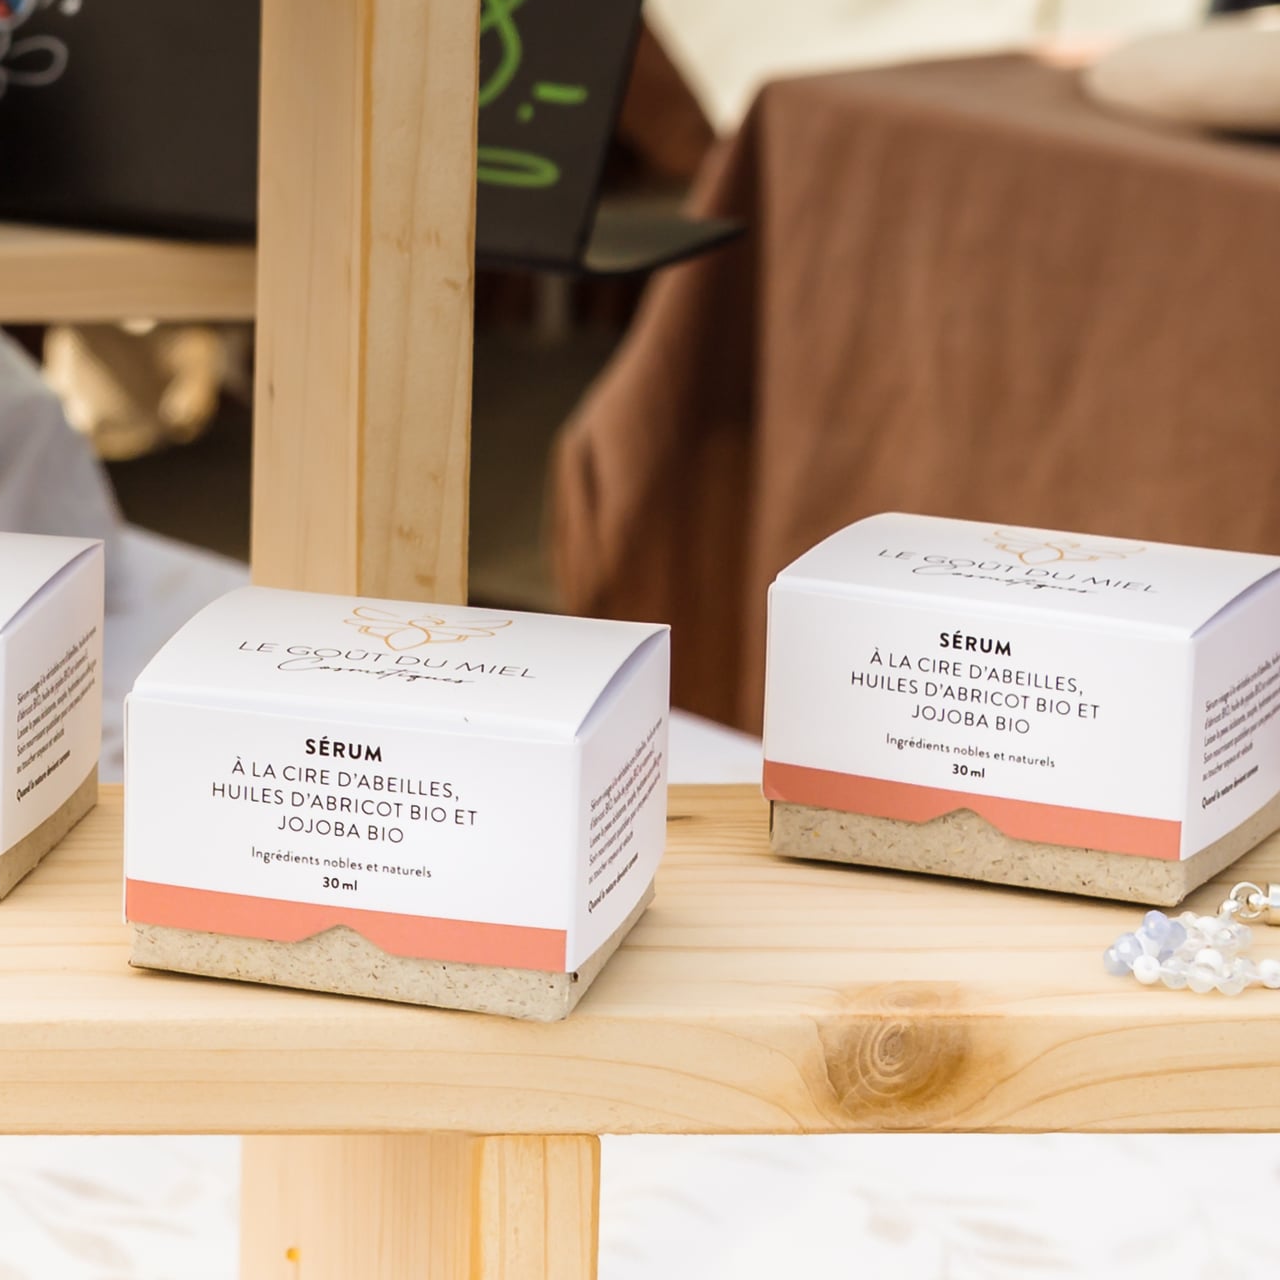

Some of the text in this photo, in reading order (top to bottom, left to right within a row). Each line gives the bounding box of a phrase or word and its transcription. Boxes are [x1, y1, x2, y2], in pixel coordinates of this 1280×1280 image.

[939, 629, 1011, 657] SÉRUM
[238, 640, 537, 681] LE GOÛT DU MIEL
[277, 656, 474, 684] Cosmétiques
[304, 735, 382, 763] SÉRUM
[231, 757, 459, 802] À LA CIRE D'ABEILLES,
[212, 781, 478, 826] HUILES D'ABRICOT BIO ET
[277, 814, 404, 844] JOJOBA BIO
[251, 845, 432, 879] Ingrédients nobles et naturels
[322, 875, 358, 891] 30 ml
